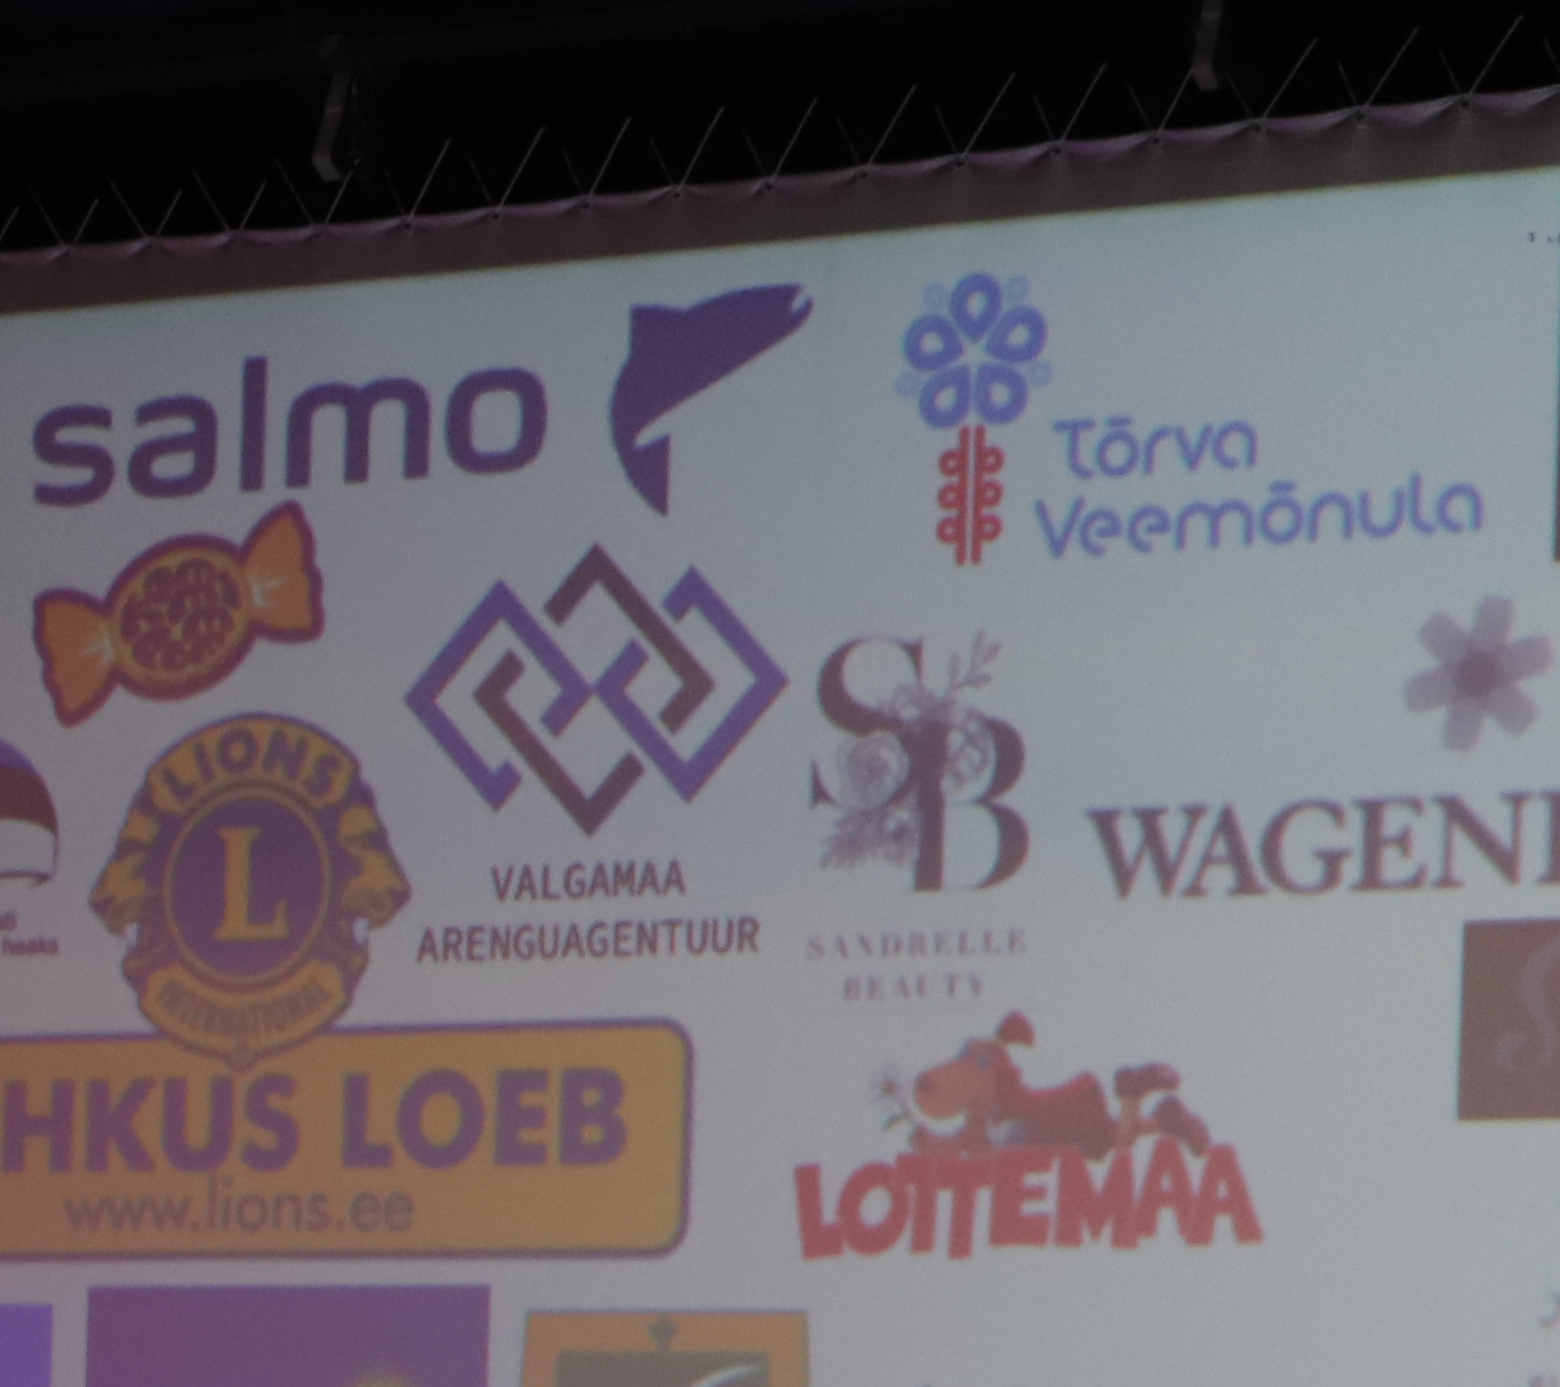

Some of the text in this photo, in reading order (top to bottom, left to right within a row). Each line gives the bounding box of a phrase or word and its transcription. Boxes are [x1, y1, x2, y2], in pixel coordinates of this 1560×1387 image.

[32, 352, 550, 508] salmo
[1052, 413, 1260, 482] Tõrva
[1032, 468, 1488, 562] Veemõnula
[160, 726, 342, 804] LIONS
[212, 823, 292, 944] L
[489, 855, 688, 905] VALGAMAA
[415, 911, 764, 964] ARENGUAGENTUUR
[340, 1066, 628, 1168] LOEB
[64, 1174, 415, 1236] www.lions.ee
[794, 1136, 1266, 1262] LOTTEMAA
